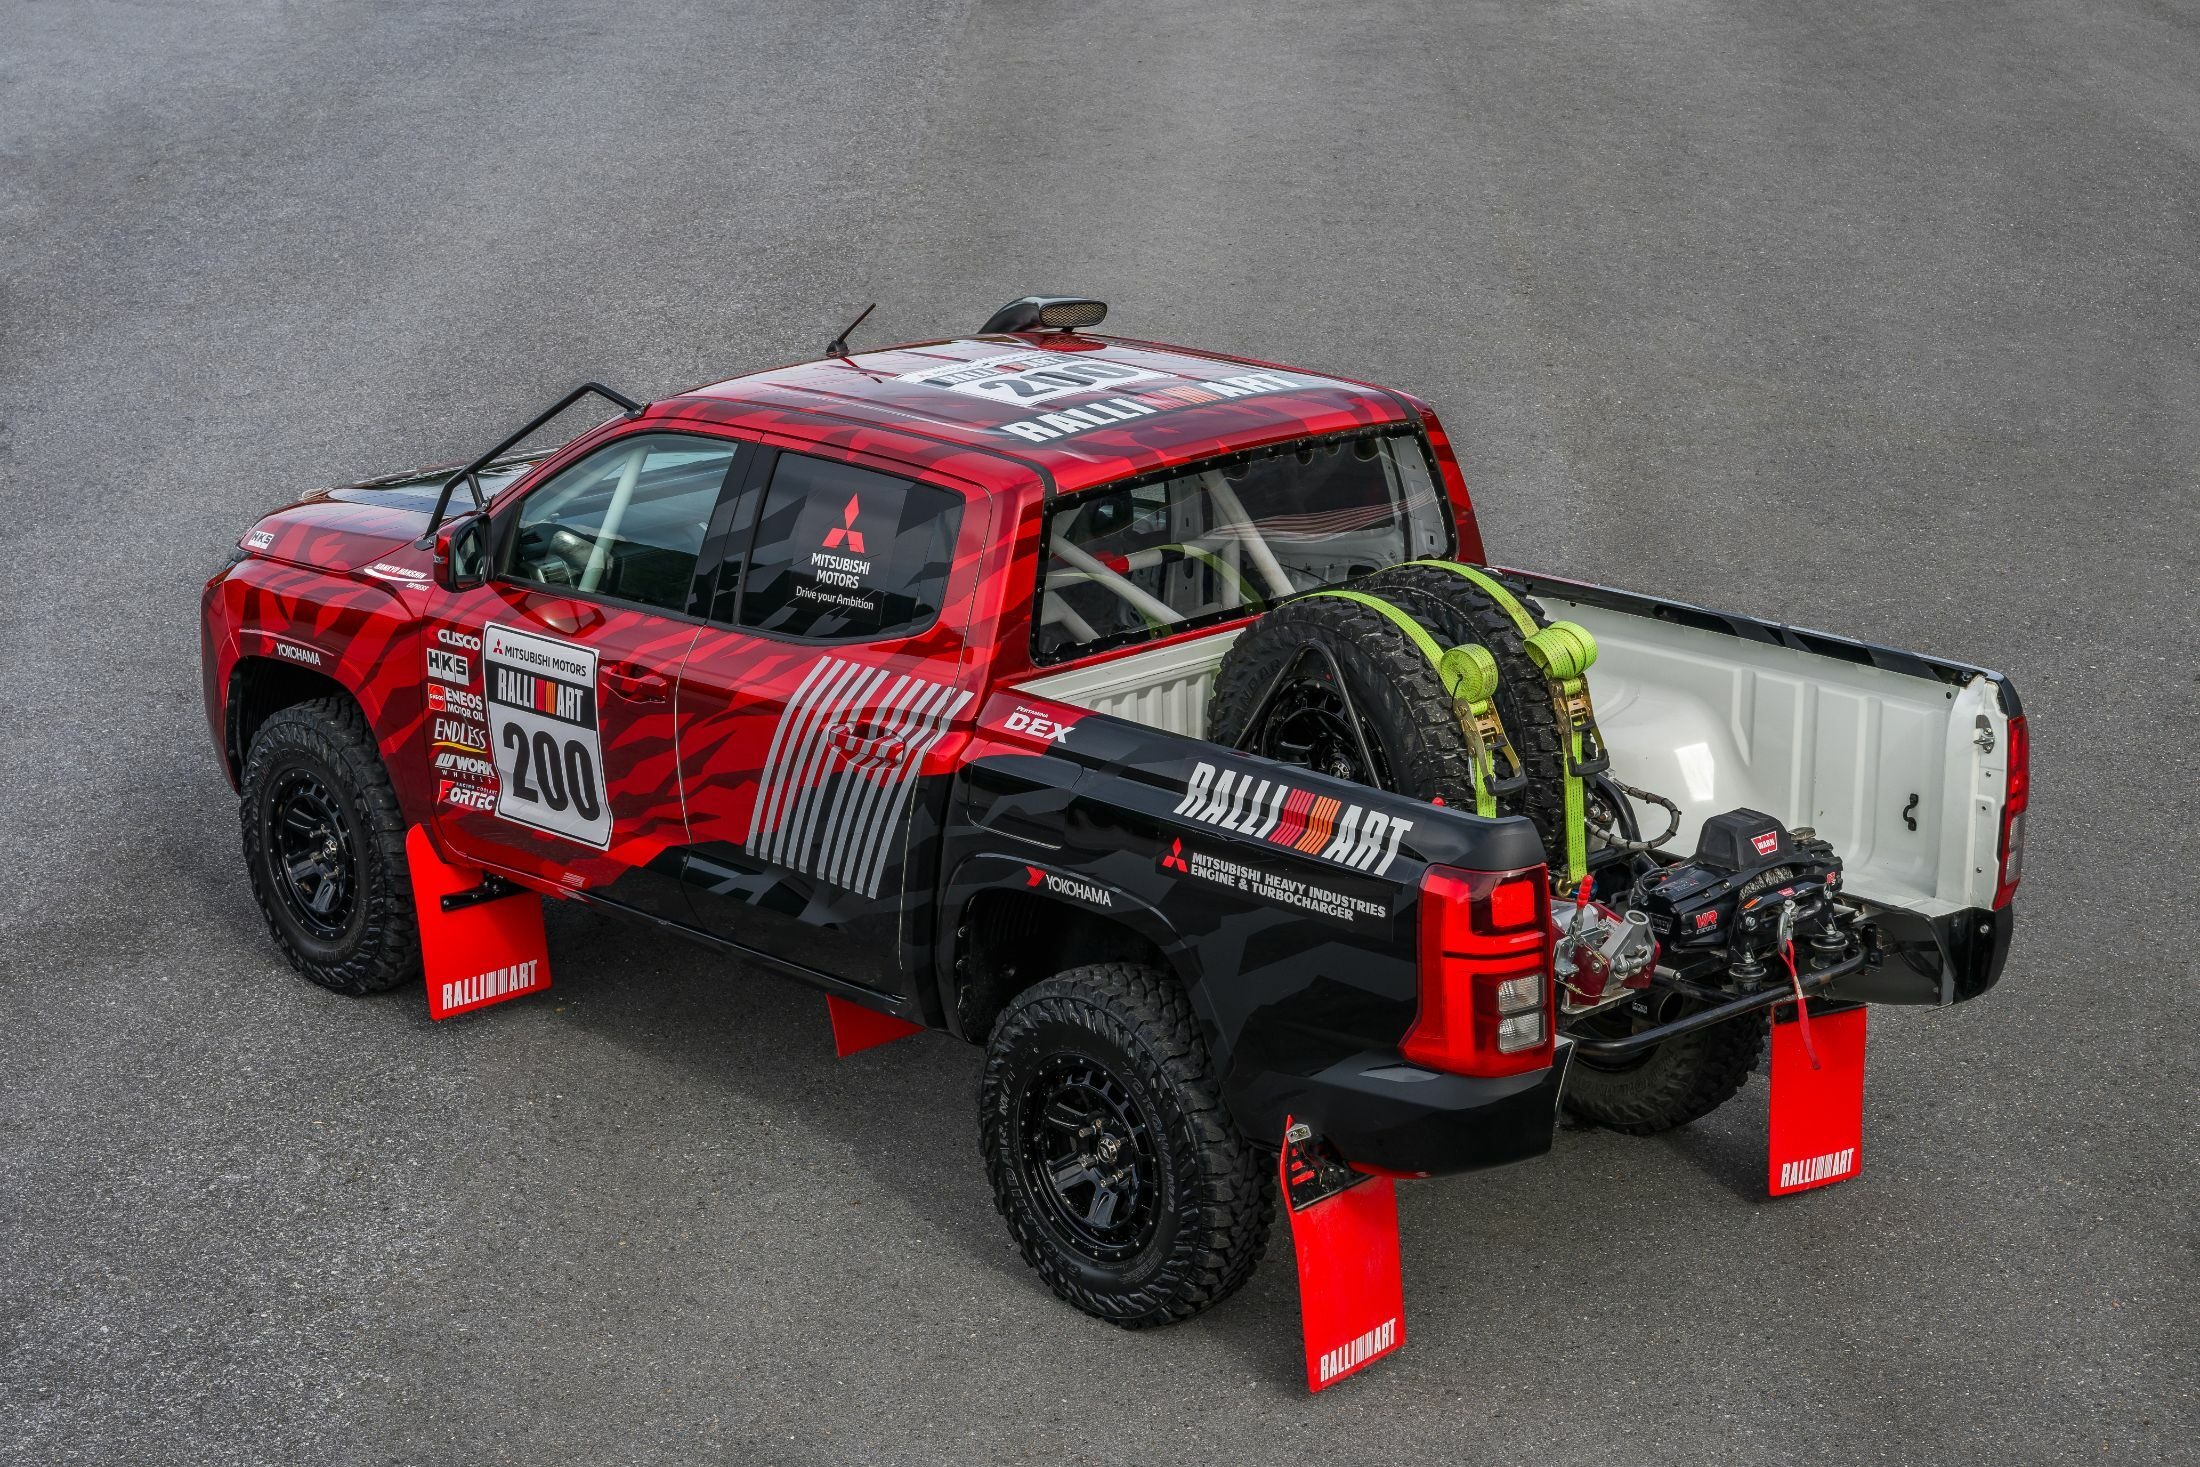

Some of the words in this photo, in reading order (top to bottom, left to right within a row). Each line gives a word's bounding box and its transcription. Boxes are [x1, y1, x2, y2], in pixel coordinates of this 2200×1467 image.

[978, 363, 1139, 397] 200
[1000, 373, 1301, 442] RALLIART
[251, 530, 272, 545] HKS
[811, 552, 871, 575] MITSUBISHI
[816, 569, 860, 589] MOTORS
[795, 585, 817, 599] Drive
[817, 592, 837, 603] your
[836, 594, 874, 611] Ambition
[276, 642, 321, 666] YOKOHAMA
[437, 628, 481, 651] CUSCO
[427, 650, 467, 676] HKS
[504, 645, 551, 667] MITSUBISHI
[552, 658, 587, 677] MOTORS
[445, 687, 483, 710] ENEOS
[497, 667, 584, 722] RALLIART
[447, 703, 472, 719] MOTOR
[472, 710, 485, 722] OIL
[1003, 711, 1077, 744] DEX
[434, 717, 486, 750] ENDLESS
[441, 769, 492, 785] WHEELS
[456, 755, 495, 777] WORK
[503, 721, 600, 822] 200
[1173, 761, 1414, 876] RALLIART
[1757, 838, 1776, 850] WARN
[1045, 874, 1112, 907] YOKOHAMA
[1190, 863, 1236, 887] ENGINE
[1238, 878, 1248, 891] &
[1251, 882, 1354, 922] TURBOCHARGER
[1192, 852, 1261, 882] MITSUBISHI
[1264, 873, 1307, 898] HEAVY
[1308, 886, 1387, 918] INDUSTRIES
[442, 959, 538, 1011] RALLIART
[1780, 1147, 1855, 1188] RALLIART
[1320, 1318, 1397, 1383] RALLIART
